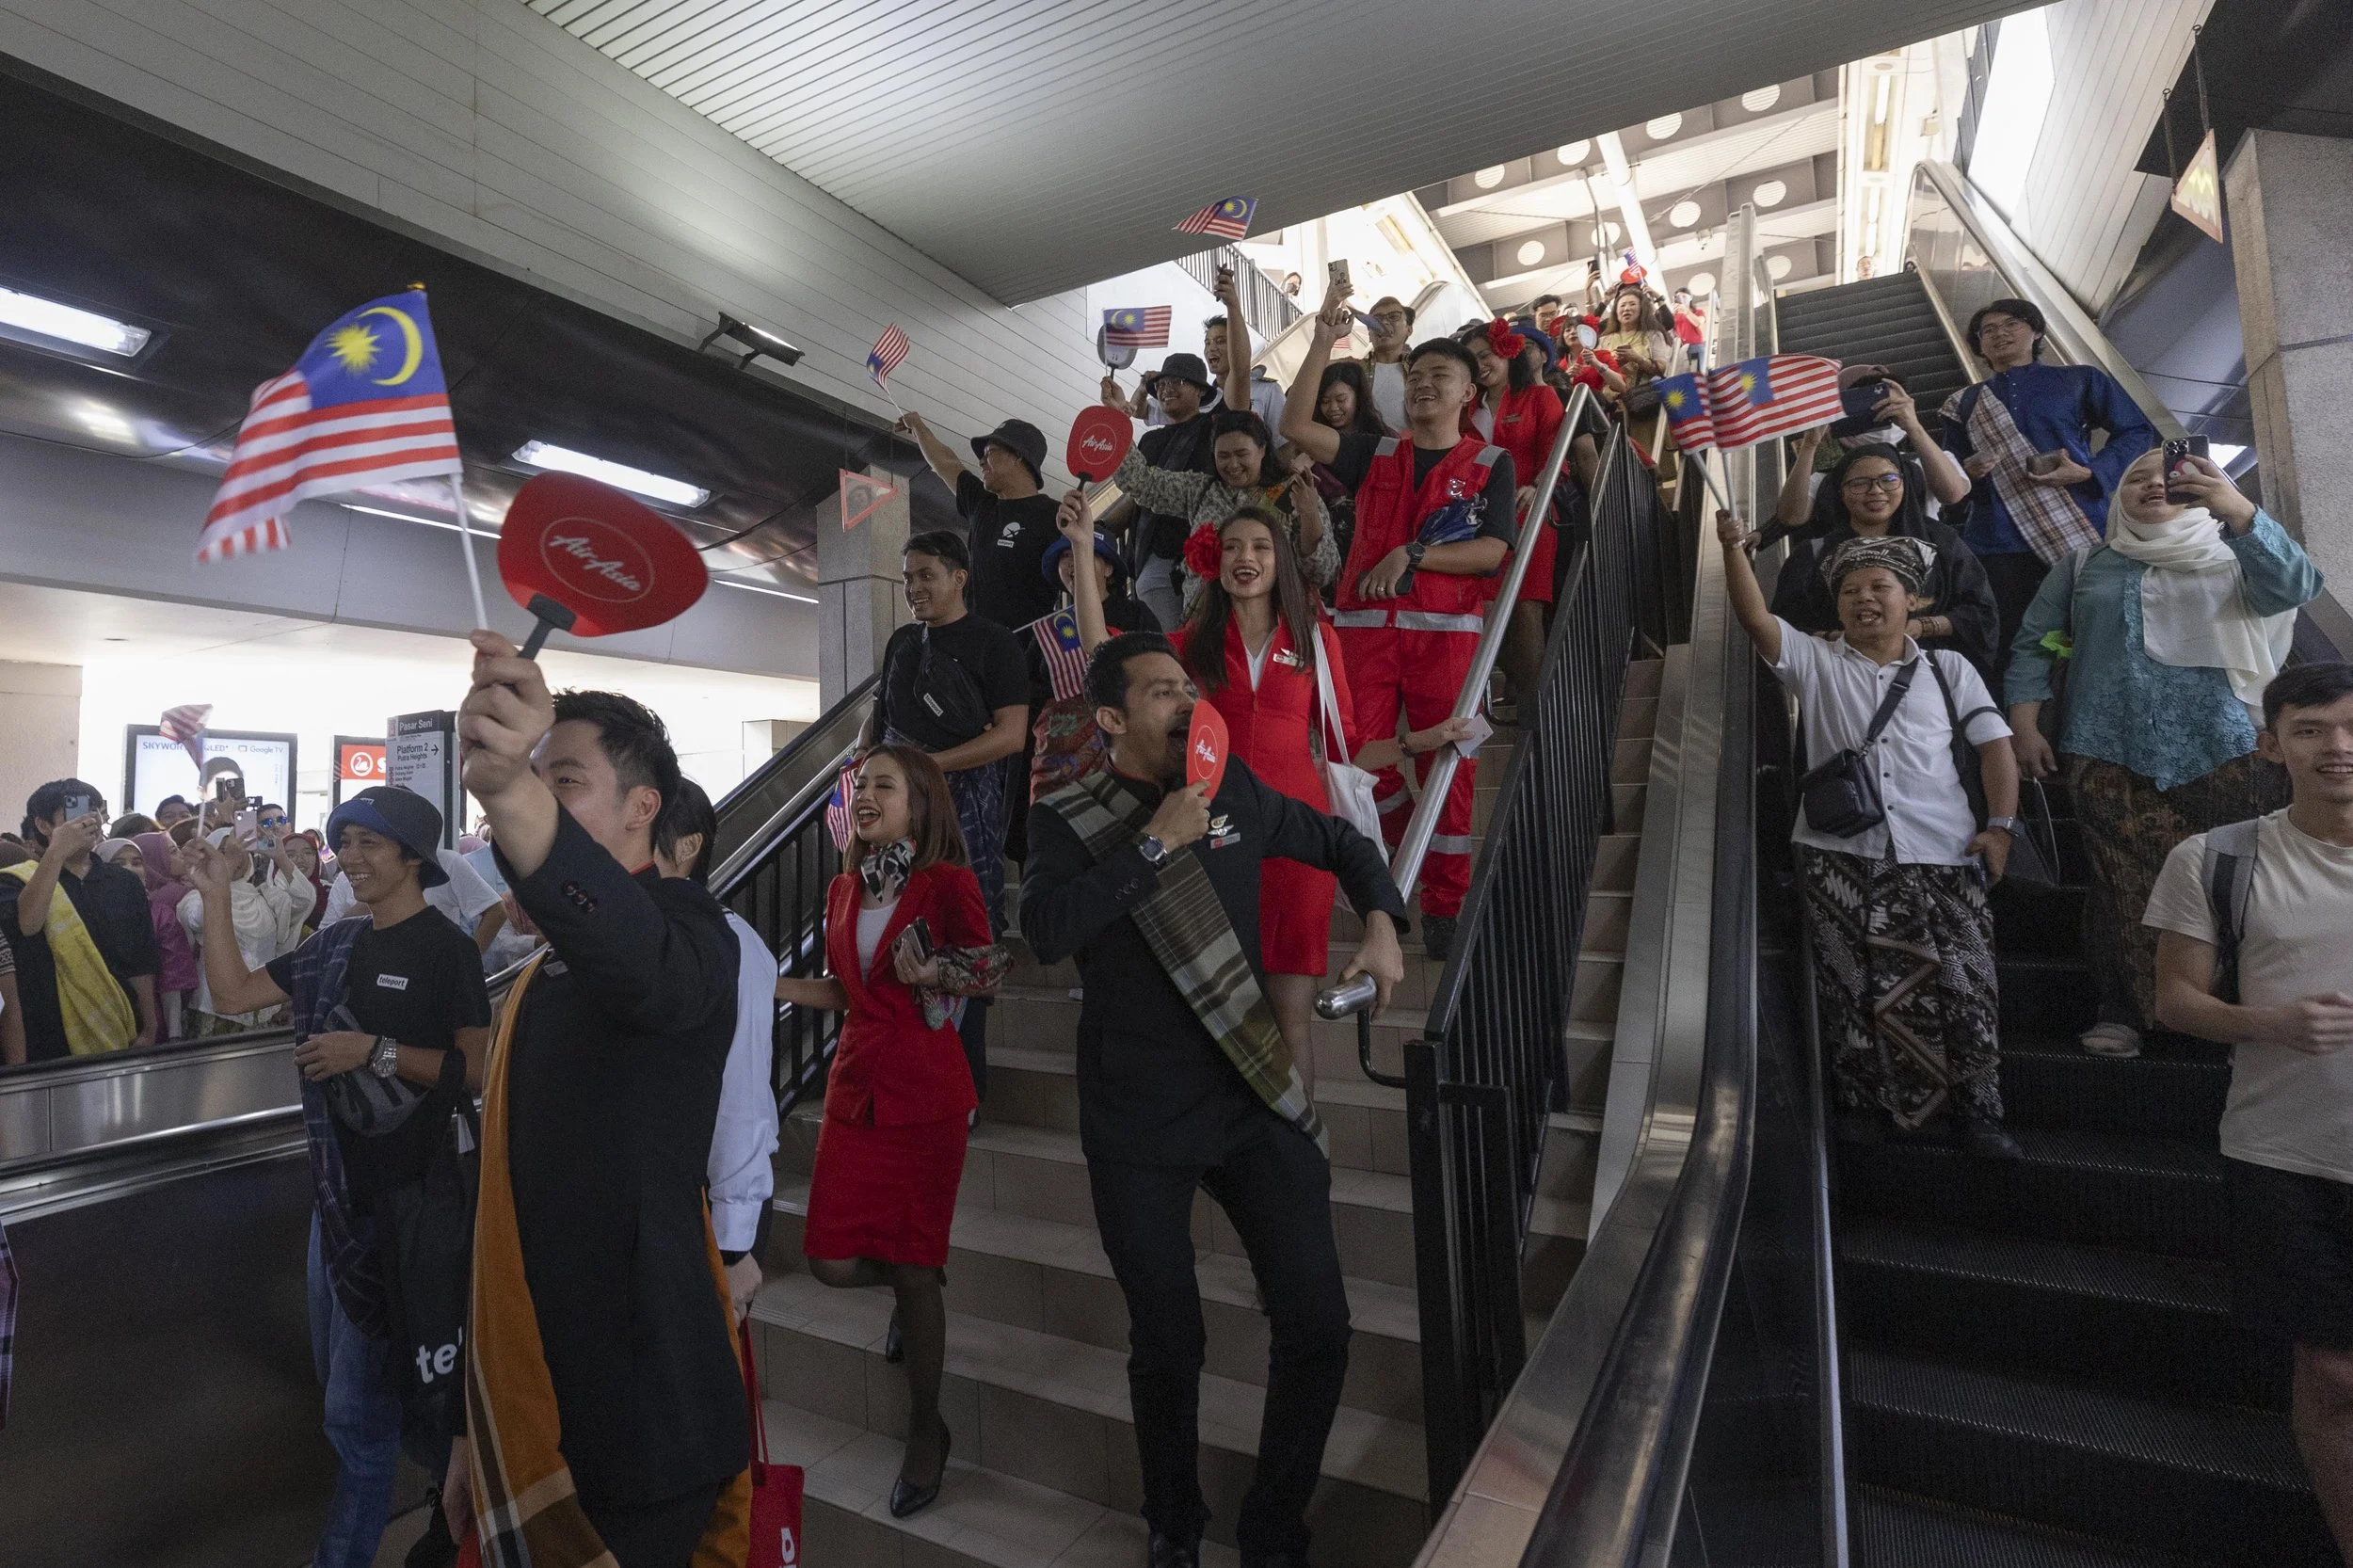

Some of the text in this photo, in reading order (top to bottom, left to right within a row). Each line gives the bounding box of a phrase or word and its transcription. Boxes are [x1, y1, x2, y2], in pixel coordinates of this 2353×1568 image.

[1081, 434, 1113, 452] AirAsia
[549, 535, 641, 591] AirAsia
[399, 718, 433, 731] Pasar Seni
[142, 741, 184, 751] SKYWOR
[249, 745, 274, 755] Google
[396, 742, 429, 754] Platform 2
[410, 752, 428, 761] Heights
[378, 976, 406, 987] teleport
